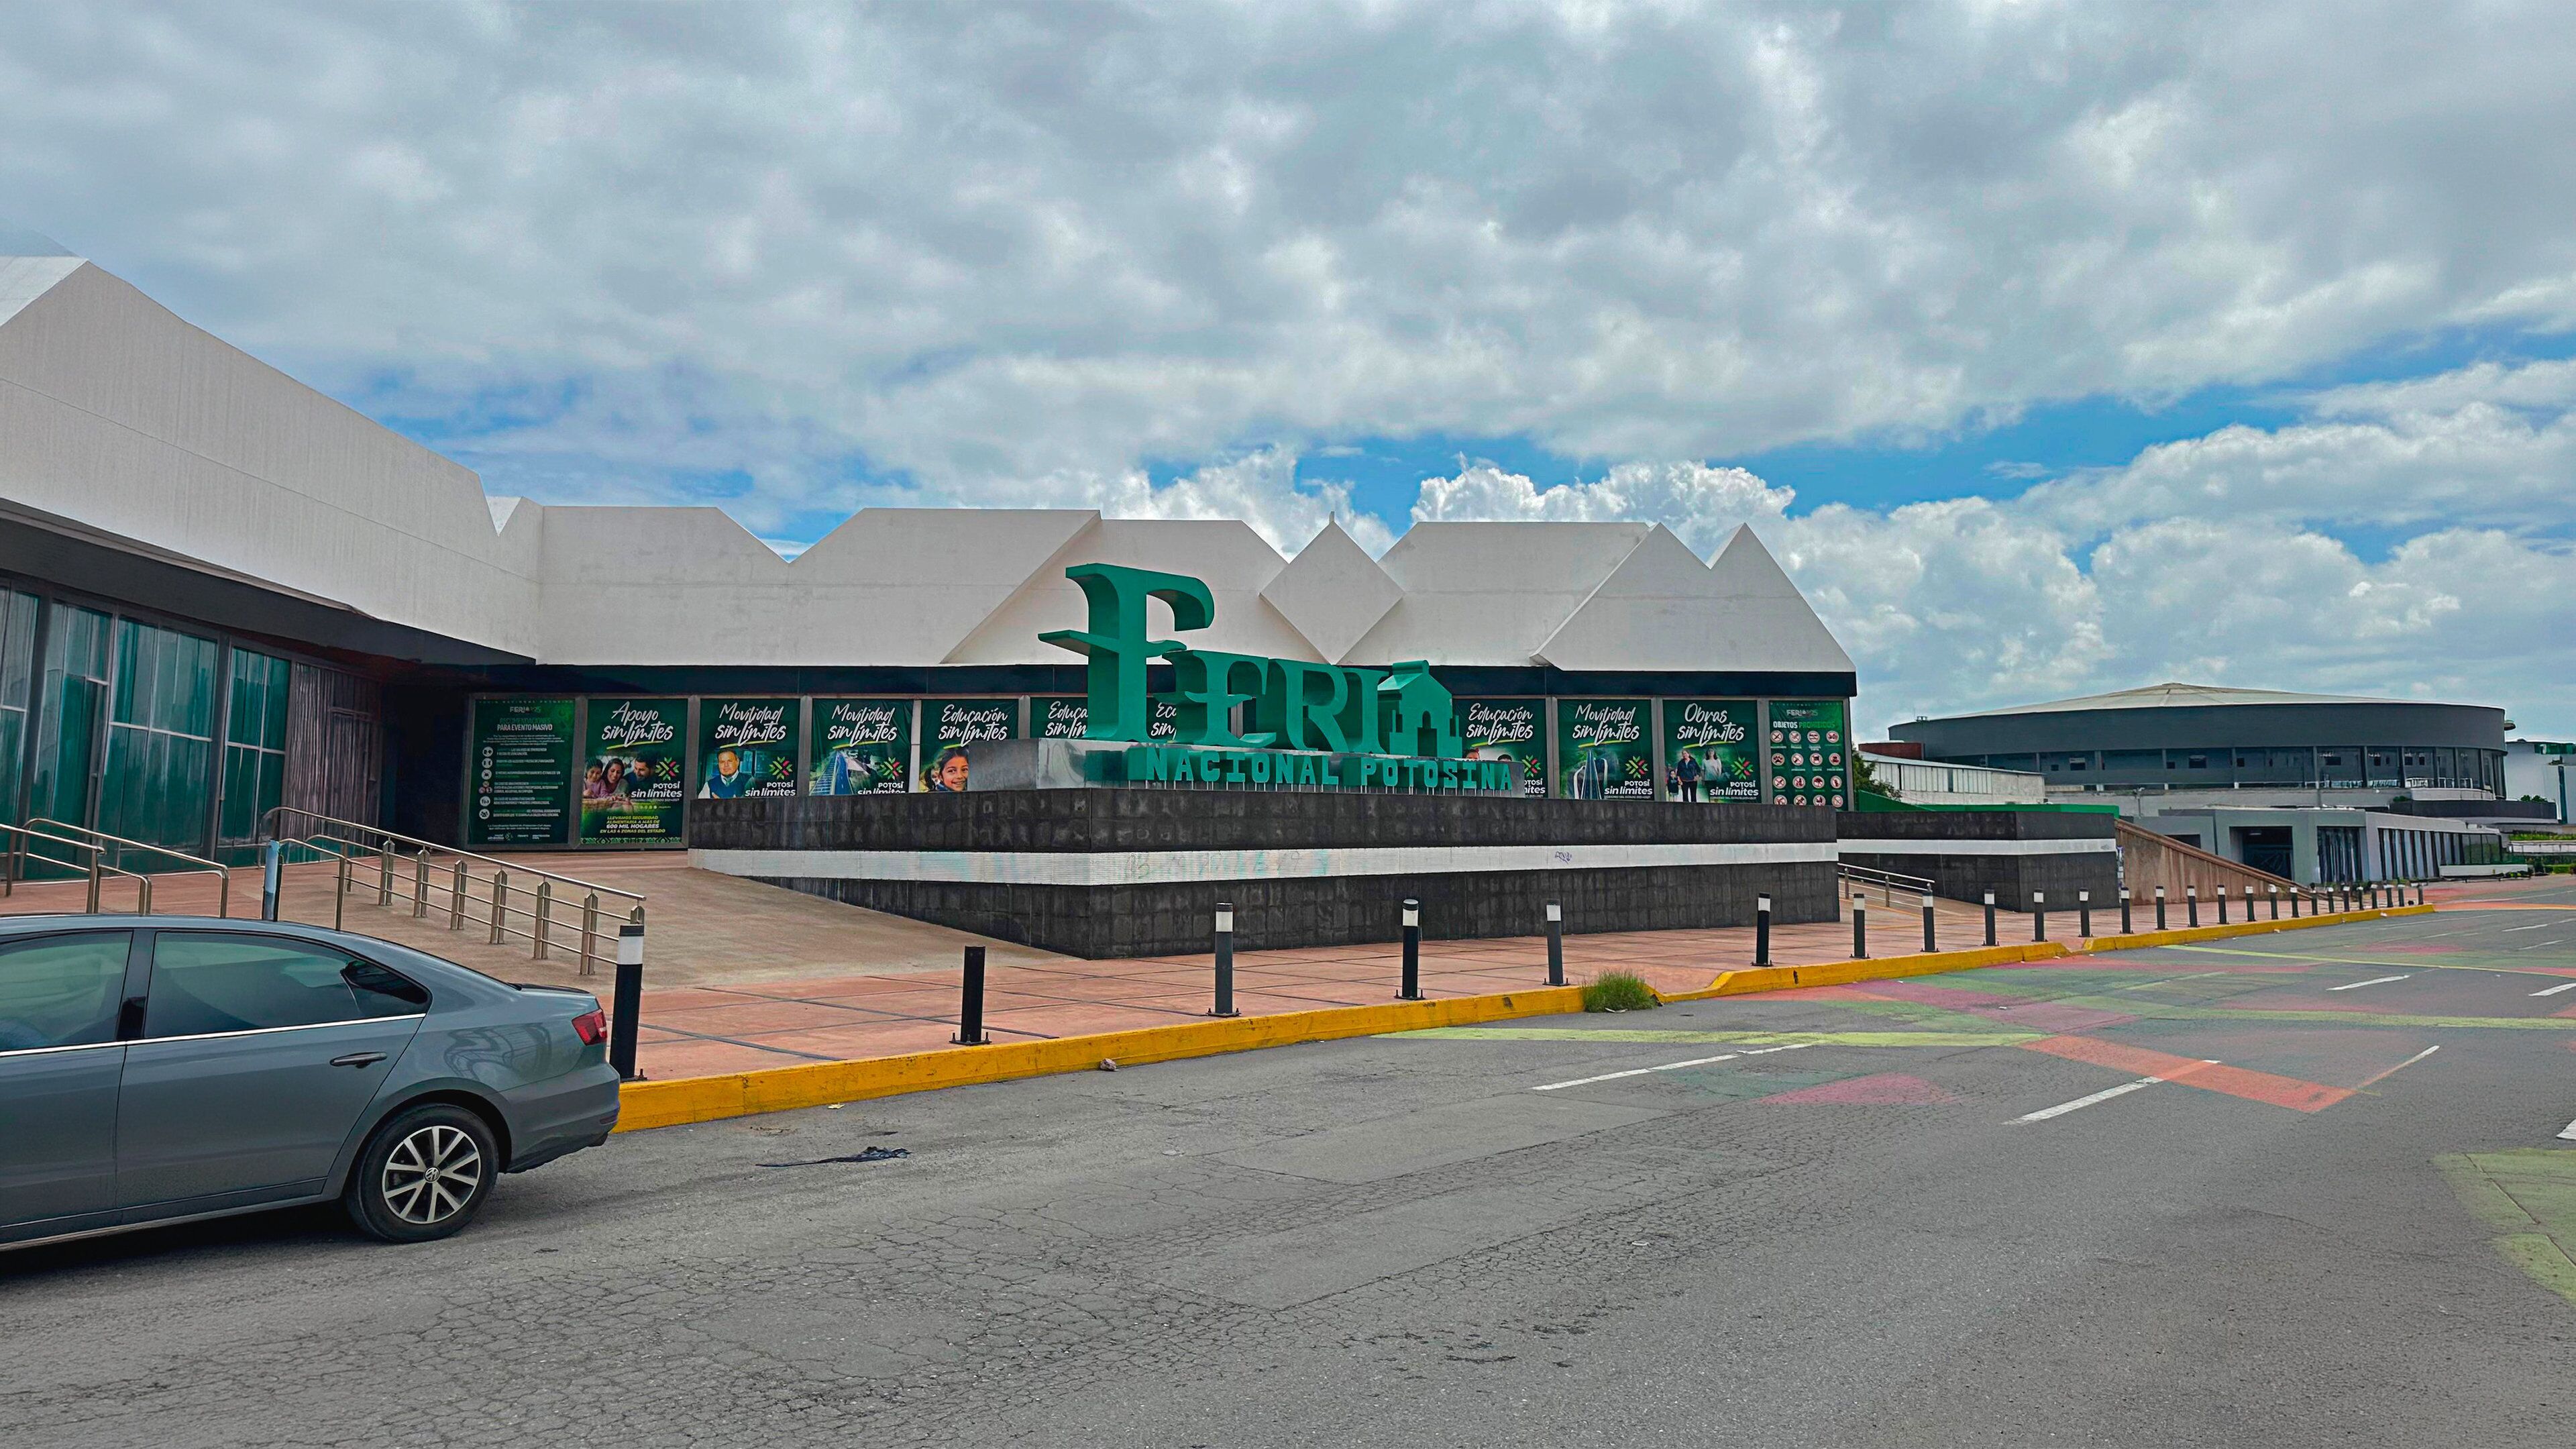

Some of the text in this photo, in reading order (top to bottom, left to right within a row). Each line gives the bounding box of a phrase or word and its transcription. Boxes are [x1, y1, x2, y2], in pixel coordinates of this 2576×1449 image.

[611, 700, 658, 727] Apoyo
[719, 702, 784, 723] Movilidad
[832, 704, 896, 724] Movilidad
[941, 704, 1008, 725] Educación
[1049, 701, 1088, 721] Educa
[1468, 703, 1533, 722] Educación
[1575, 704, 1636, 723] Movilidad
[1684, 703, 1727, 723] Obras
[1146, 747, 1512, 790] NACIONAL POTOSINA
[631, 789, 646, 798] sin
[745, 788, 759, 796] sin
[1605, 786, 1619, 794] sin
[1710, 787, 1725, 796] sin
